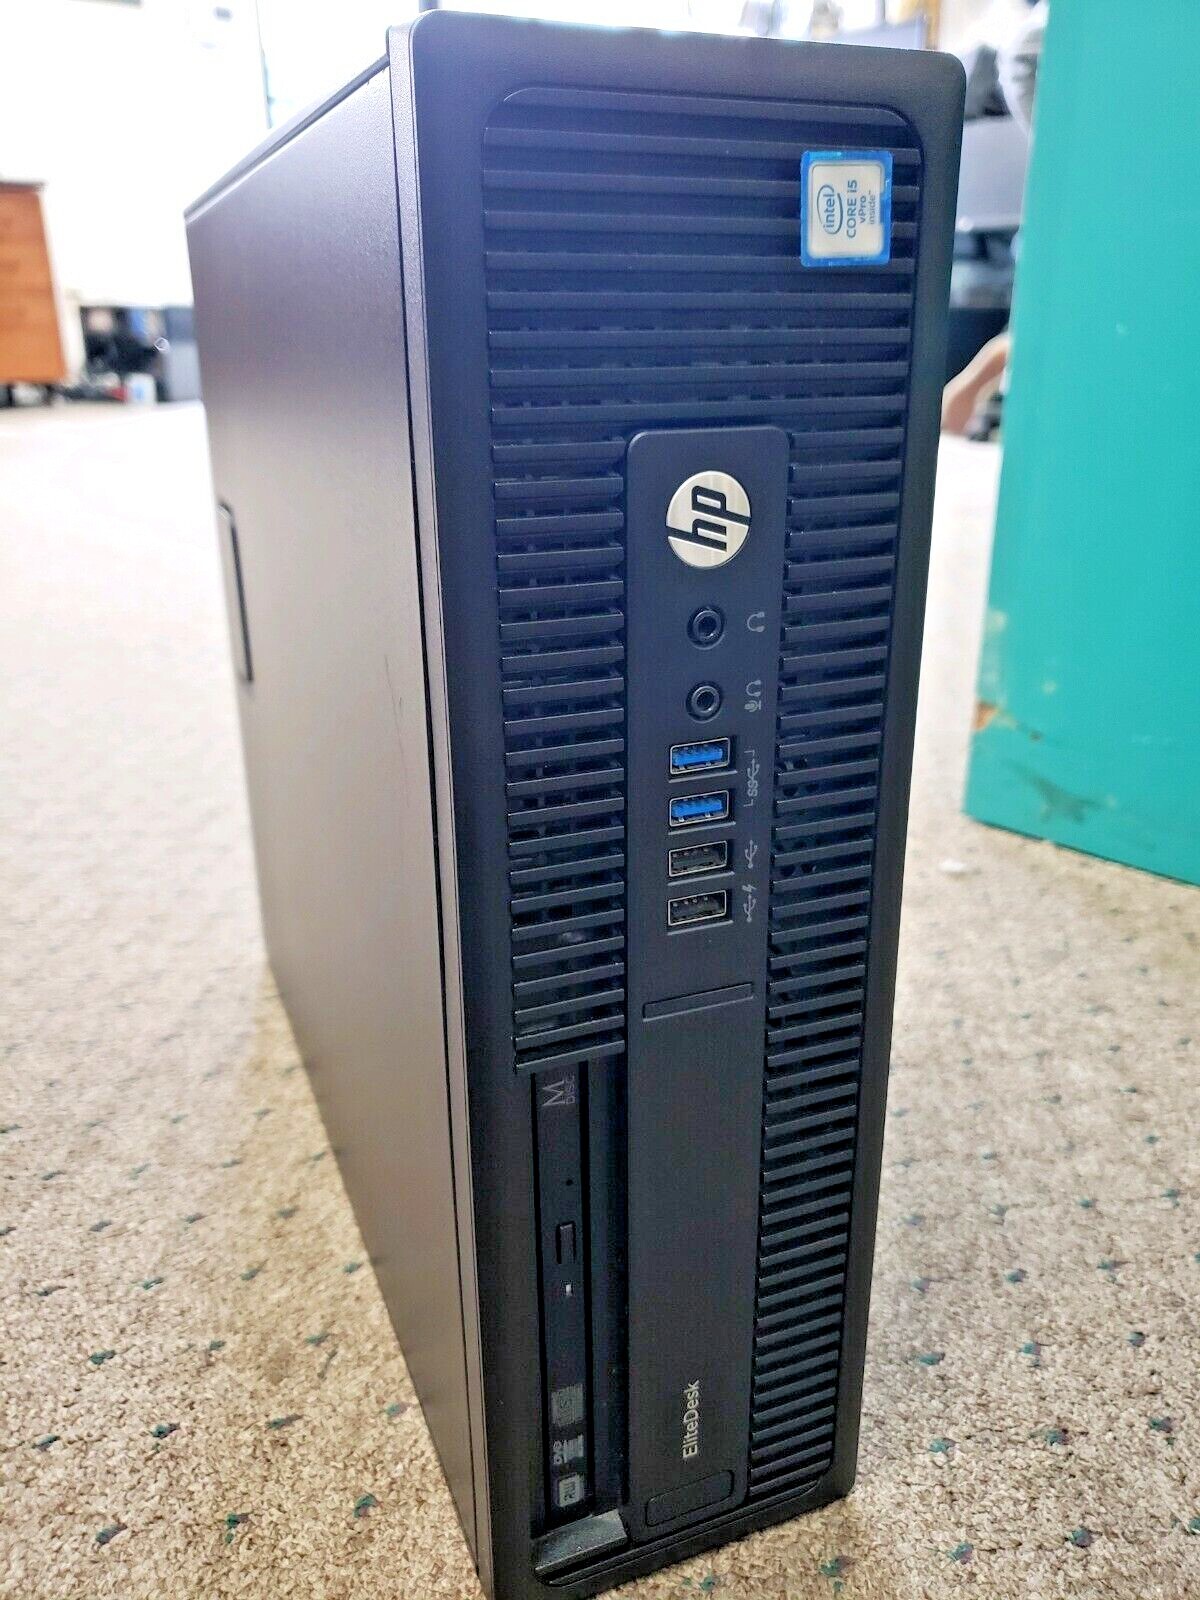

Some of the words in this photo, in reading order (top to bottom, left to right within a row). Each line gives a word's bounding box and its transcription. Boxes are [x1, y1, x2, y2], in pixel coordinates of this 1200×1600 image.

[847, 179, 858, 193] i5
[823, 193, 835, 228] intel
[846, 198, 857, 238] CORE
[858, 195, 867, 224] vPro
[667, 484, 751, 554] hp
[683, 1379, 700, 1459] EliteDesk
